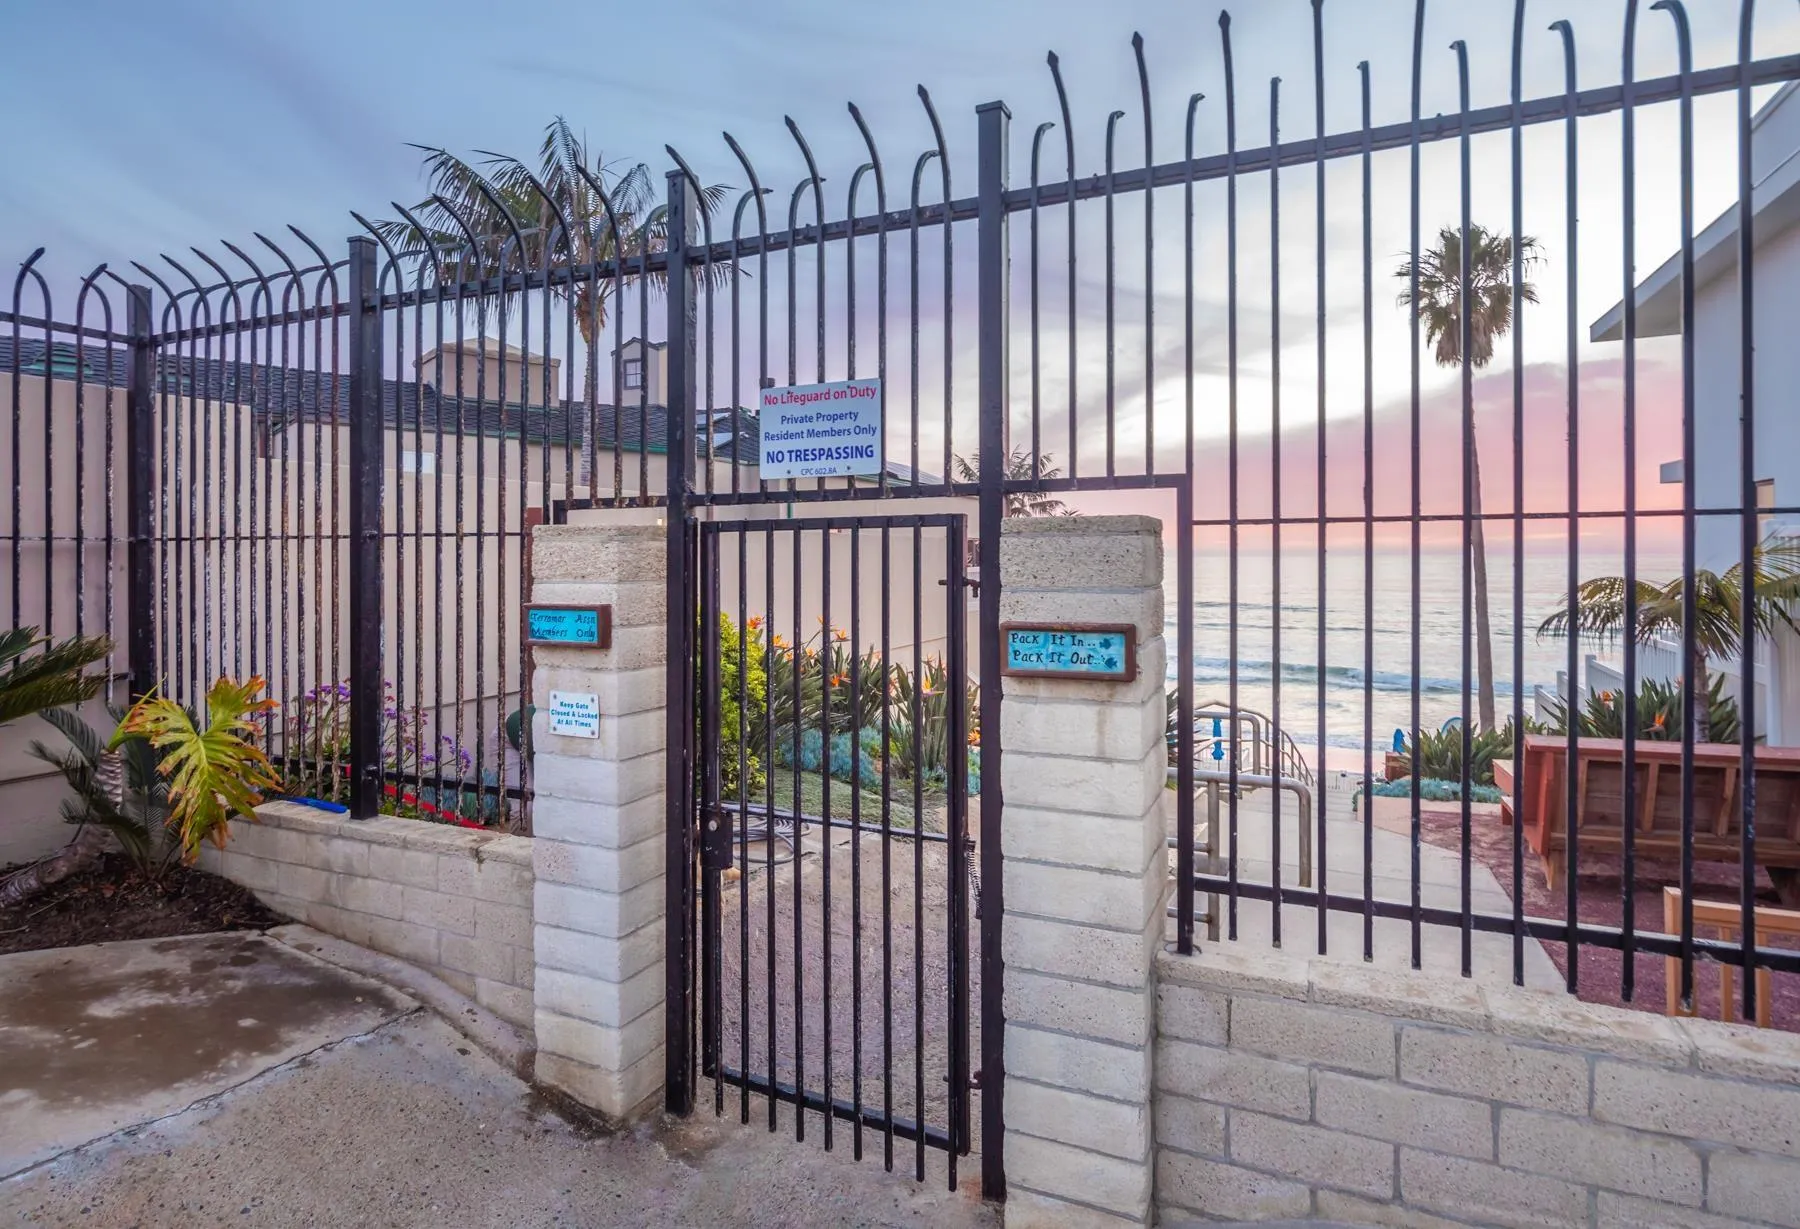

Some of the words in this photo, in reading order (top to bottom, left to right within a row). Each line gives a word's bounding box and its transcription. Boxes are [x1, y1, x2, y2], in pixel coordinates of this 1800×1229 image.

[764, 395, 778, 405] No
[781, 389, 831, 405] Lifeguard
[833, 390, 847, 400] on
[850, 386, 877, 399] Duty
[781, 414, 814, 425] Private
[816, 411, 859, 423] Property
[764, 430, 804, 441] Resident
[806, 427, 851, 438] Members
[853, 424, 877, 437] Only
[766, 450, 785, 464] NO
[787, 445, 874, 462] TRESPASSING
[801, 467, 814, 476] CPC
[531, 624, 568, 637] Members
[576, 626, 596, 642] Only
[1011, 632, 1039, 645] Pack
[1051, 634, 1066, 646] It
[1013, 650, 1044, 663] Pack
[1049, 651, 1065, 663] It
[560, 701, 574, 709] Keep
[576, 702, 589, 710] Gate
[551, 709, 570, 717] Closed
[578, 712, 598, 720] Locked
[575, 720, 592, 728] Times
